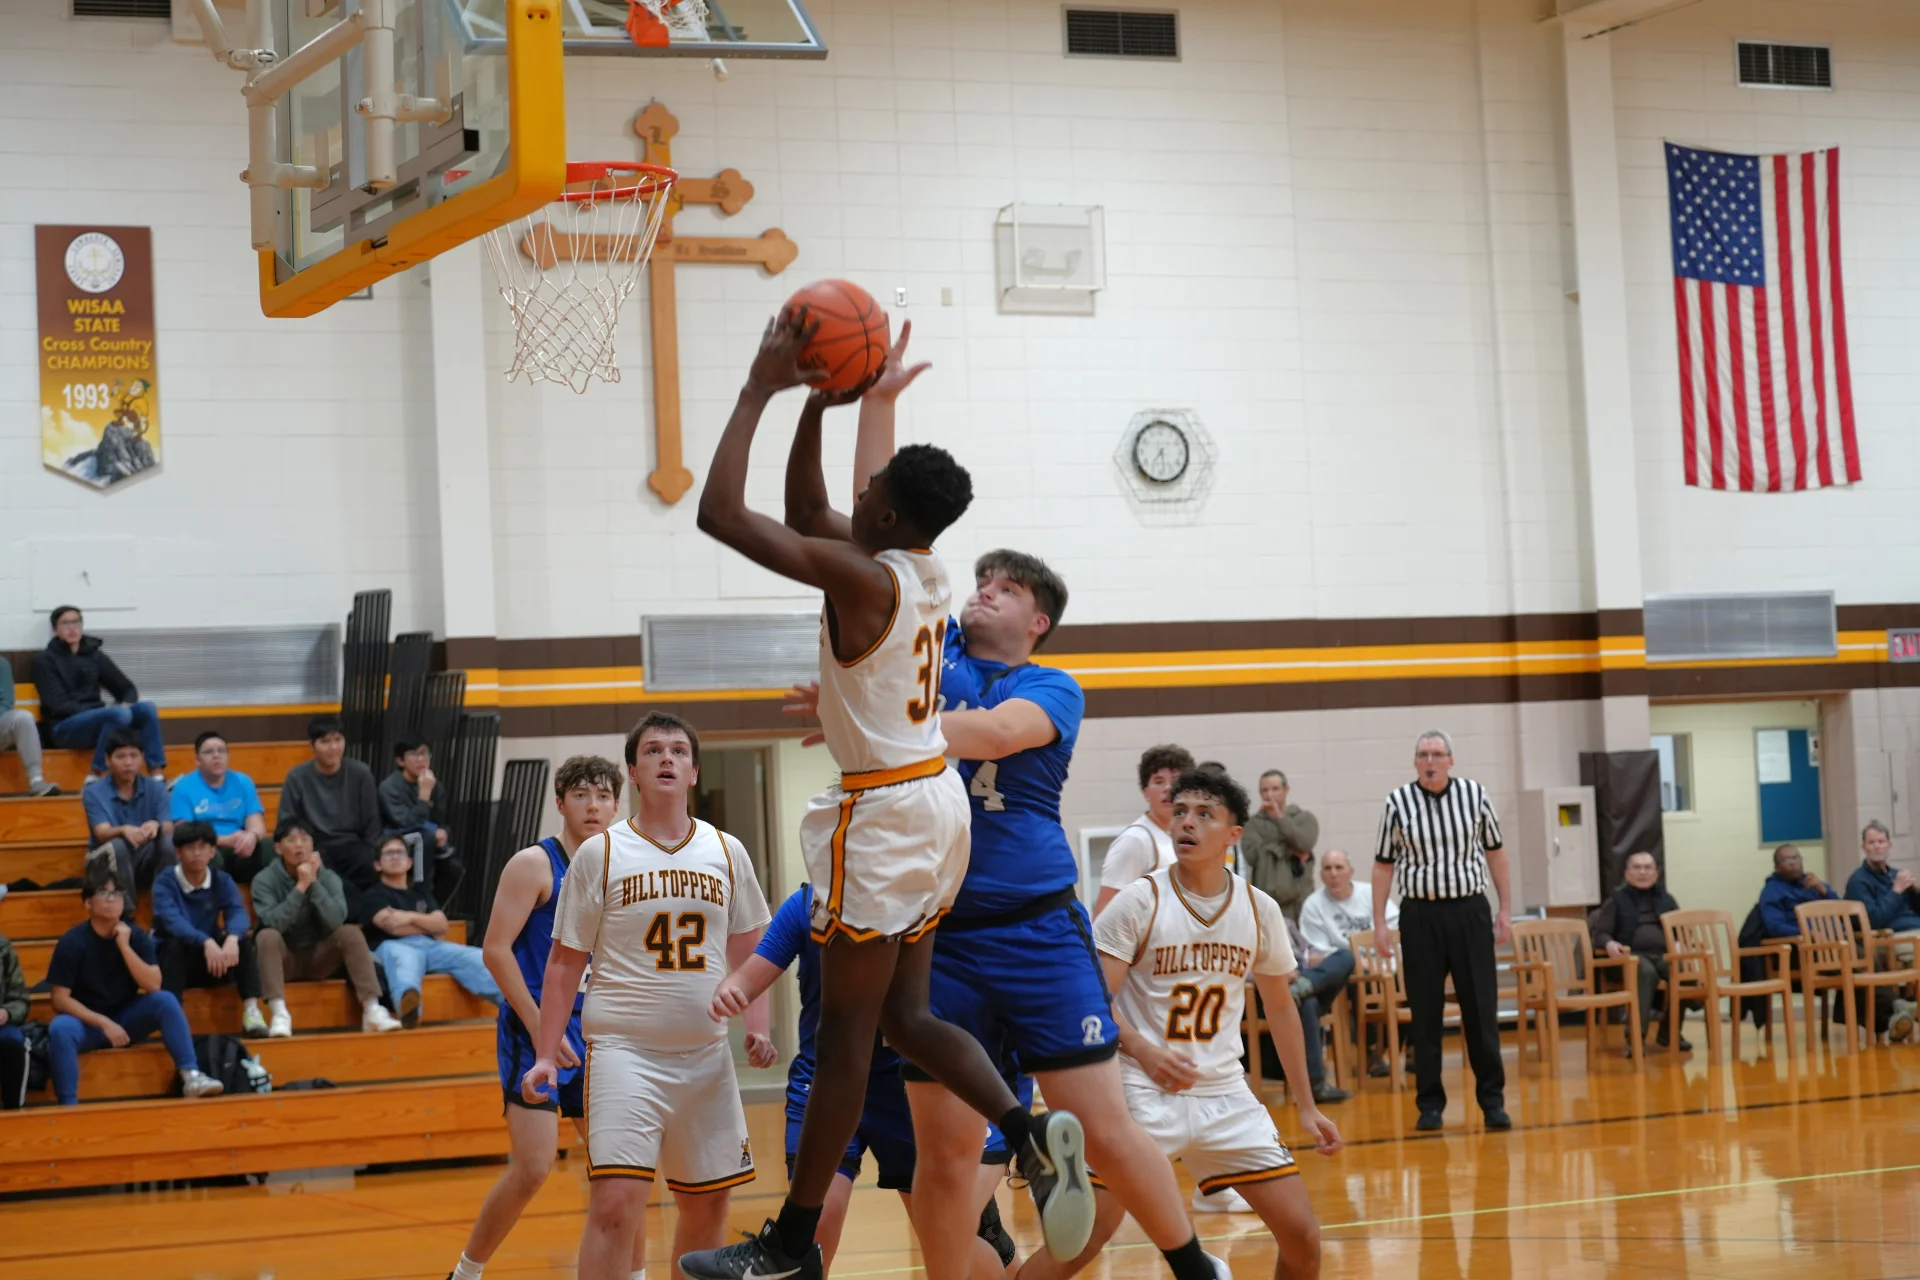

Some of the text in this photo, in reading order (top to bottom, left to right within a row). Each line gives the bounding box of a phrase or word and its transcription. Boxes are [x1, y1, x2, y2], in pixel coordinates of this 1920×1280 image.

[67, 298, 126, 315] WISAA
[74, 318, 120, 333] STATE
[43, 336, 152, 355] Cross Country
[47, 355, 150, 370] CHAMPIONS
[62, 383, 110, 409] 1993
[906, 618, 946, 725] 31
[622, 869, 724, 907] HILLTOPPERS
[643, 911, 707, 971] 42
[1153, 942, 1250, 978] HILLTOPPERS
[1165, 982, 1227, 1043] 20
